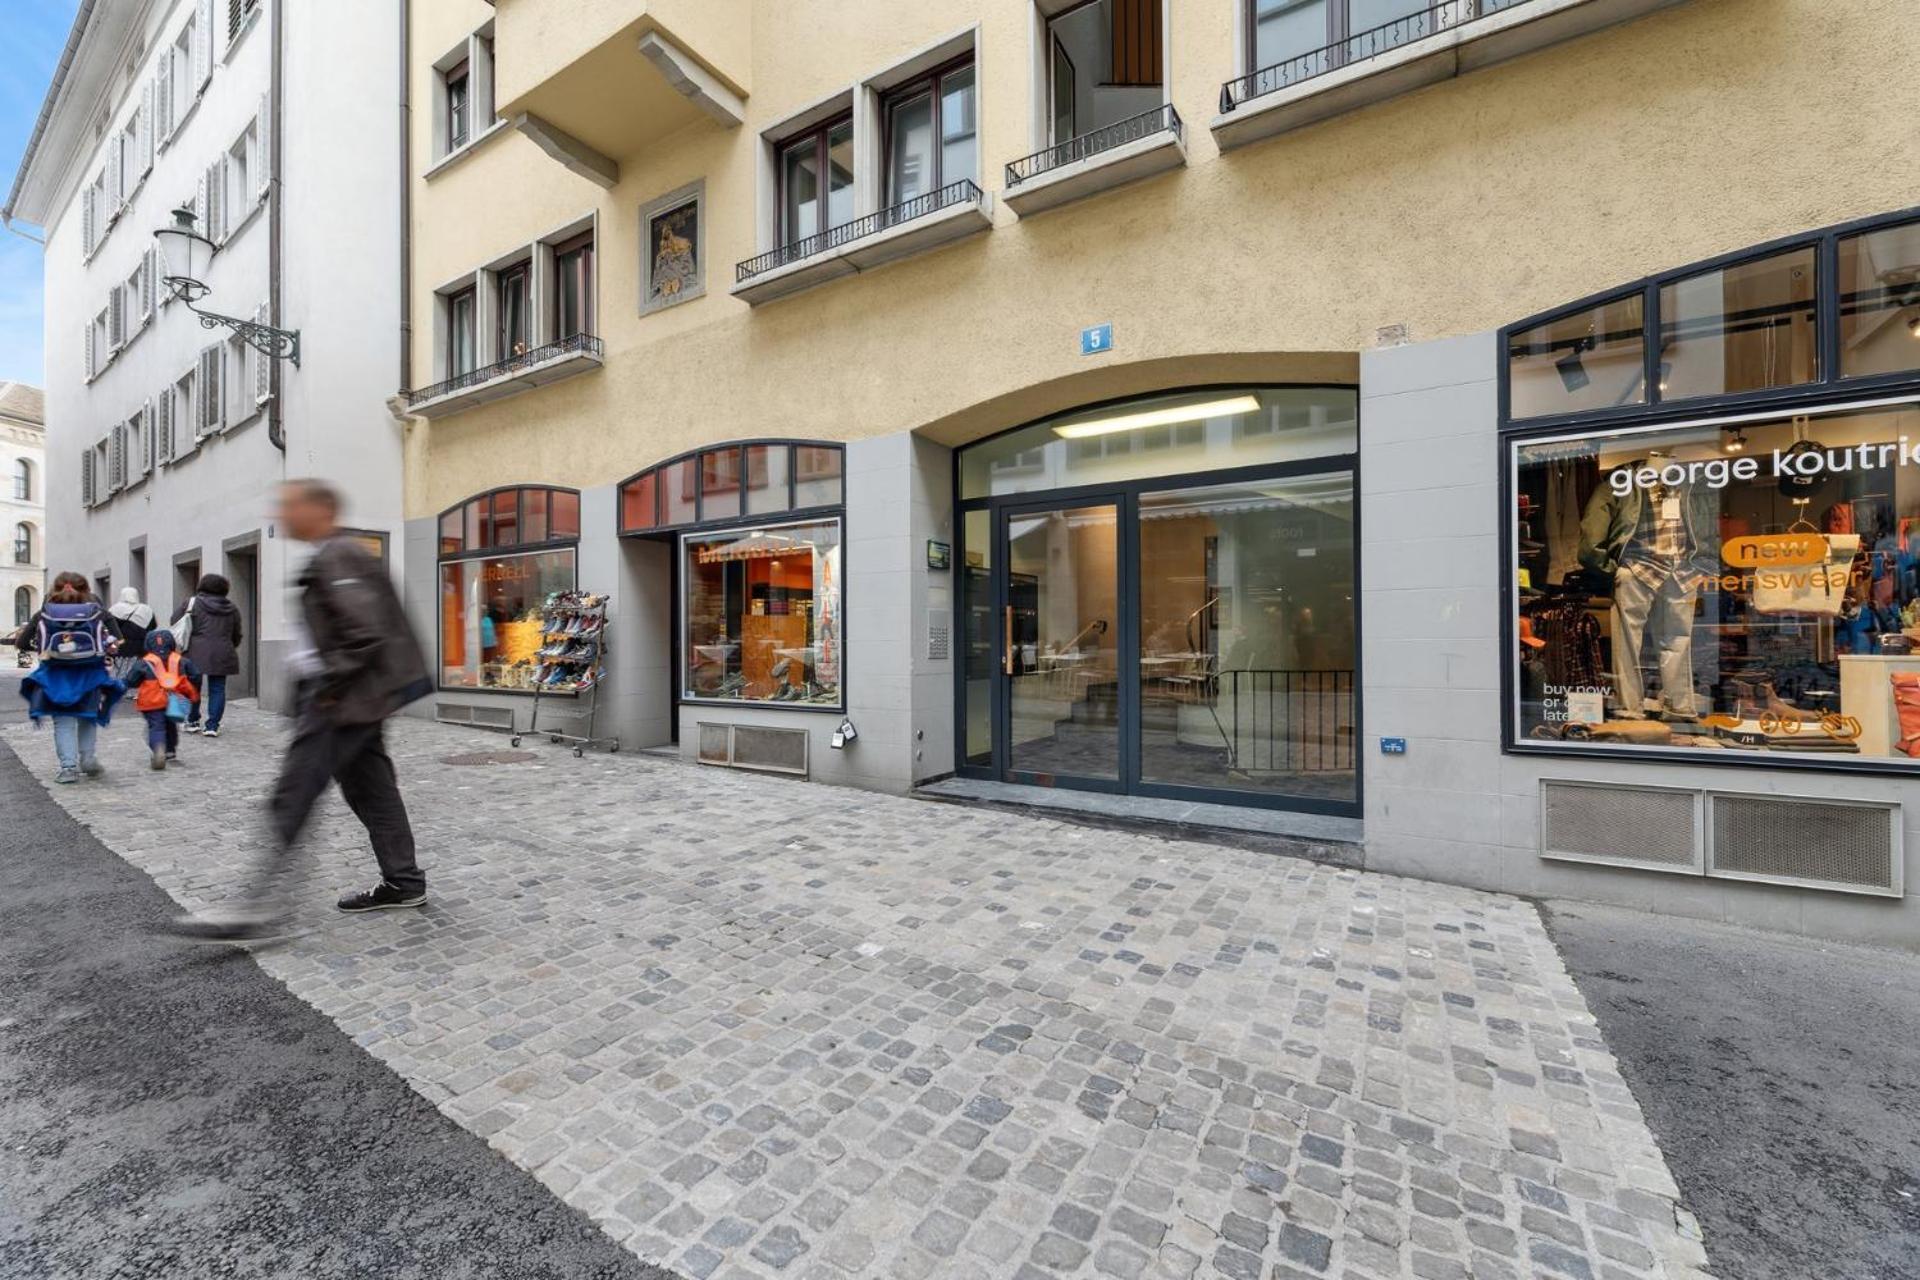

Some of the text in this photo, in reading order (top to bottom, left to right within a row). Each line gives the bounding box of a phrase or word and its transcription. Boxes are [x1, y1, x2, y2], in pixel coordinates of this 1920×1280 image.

[1090, 330, 1100, 348] 5
[1609, 457, 1758, 497] george
[1740, 541, 1809, 560] new
[1692, 570, 1862, 592] menswear
[1543, 682, 1610, 696] buy now
[1543, 698, 1560, 708] or
[1543, 709, 1569, 721] late
